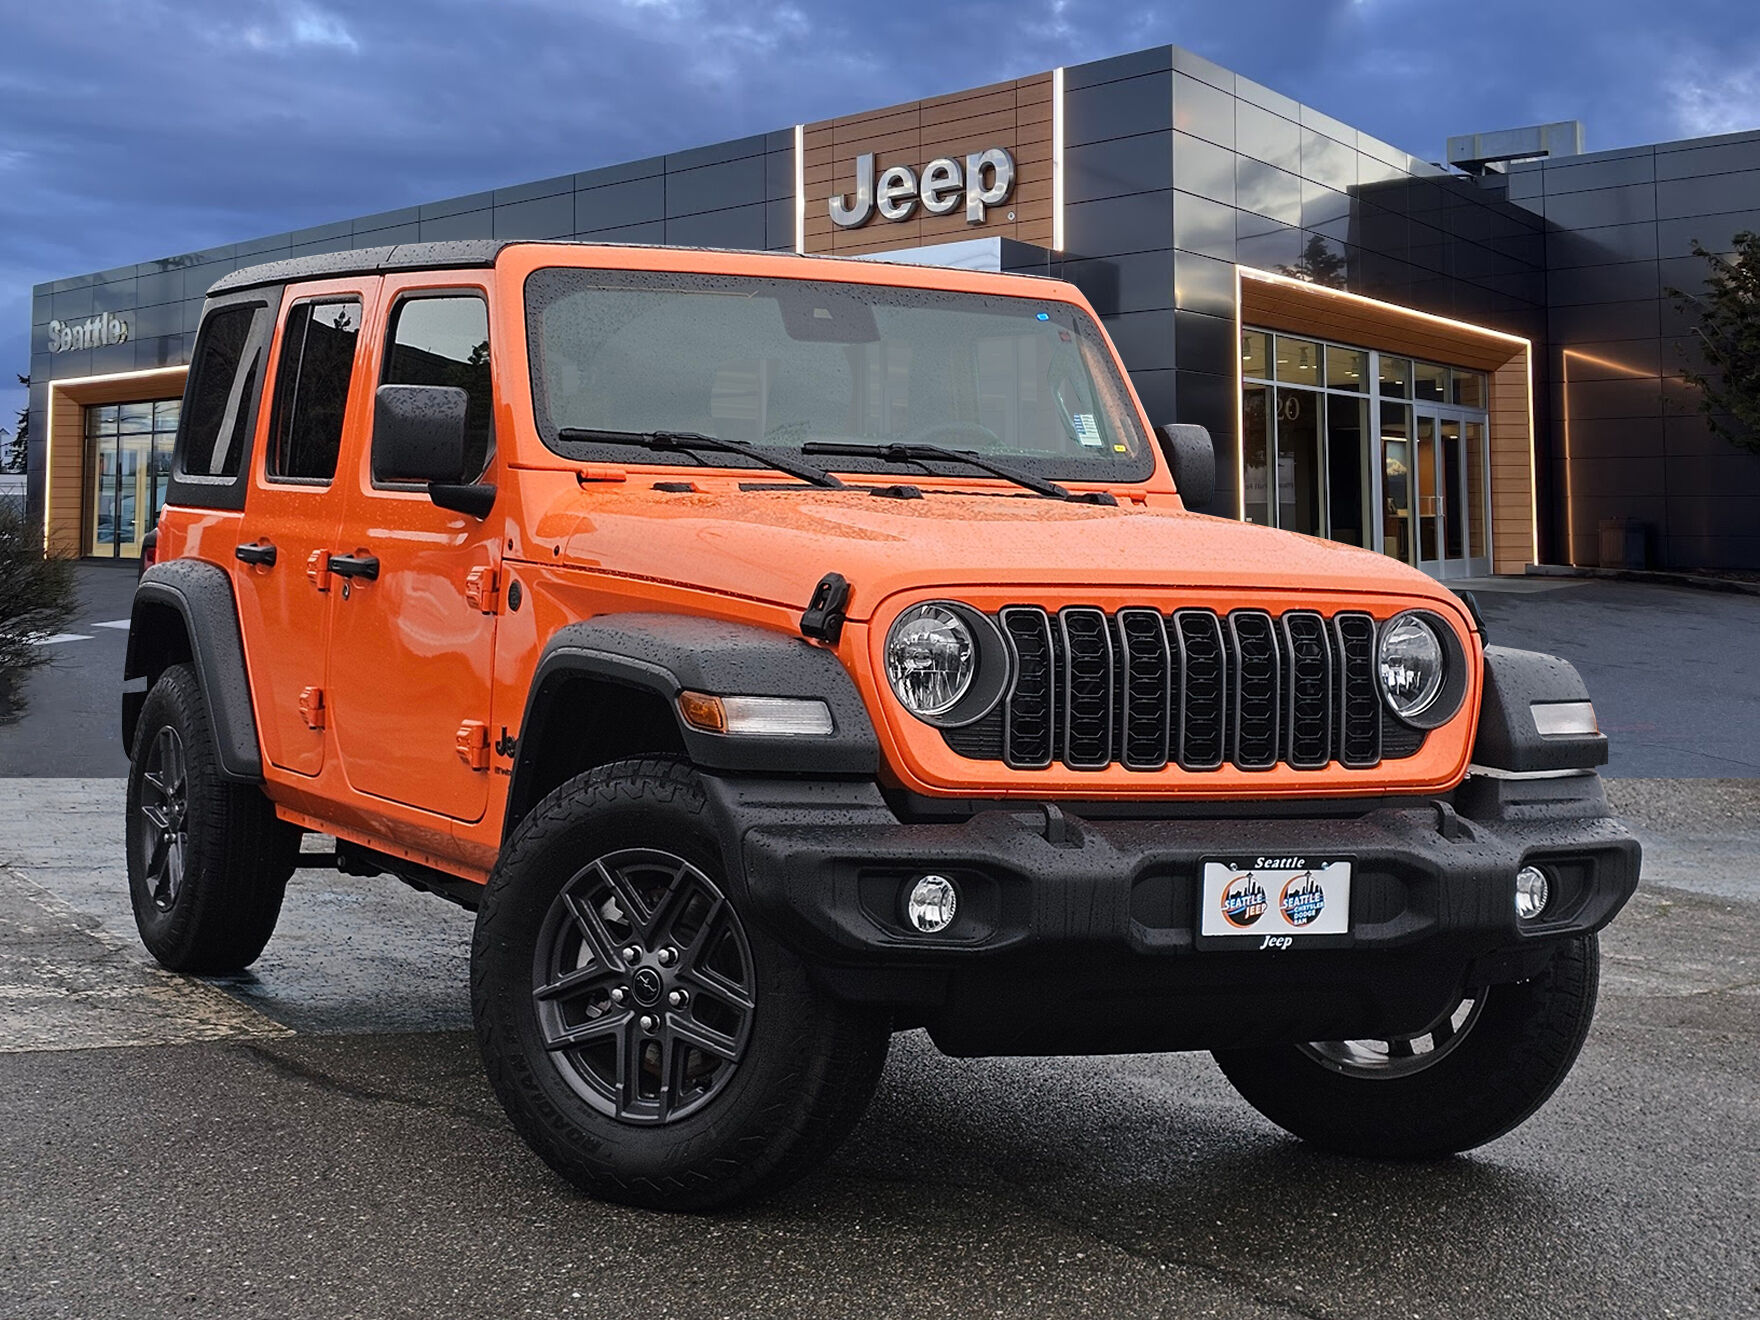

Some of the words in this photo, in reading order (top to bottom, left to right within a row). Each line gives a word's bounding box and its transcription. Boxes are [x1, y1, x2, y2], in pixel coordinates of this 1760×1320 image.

[828, 147, 1016, 229] Jeep
[48, 311, 128, 353] Seattle
[1254, 856, 1306, 869] Seattle
[1224, 893, 1263, 909] SEATTLE
[1283, 892, 1321, 908] SEATTLE
[1245, 903, 1267, 919] JEEP
[1294, 910, 1316, 919] DODGE
[1259, 935, 1293, 950] Jeep
